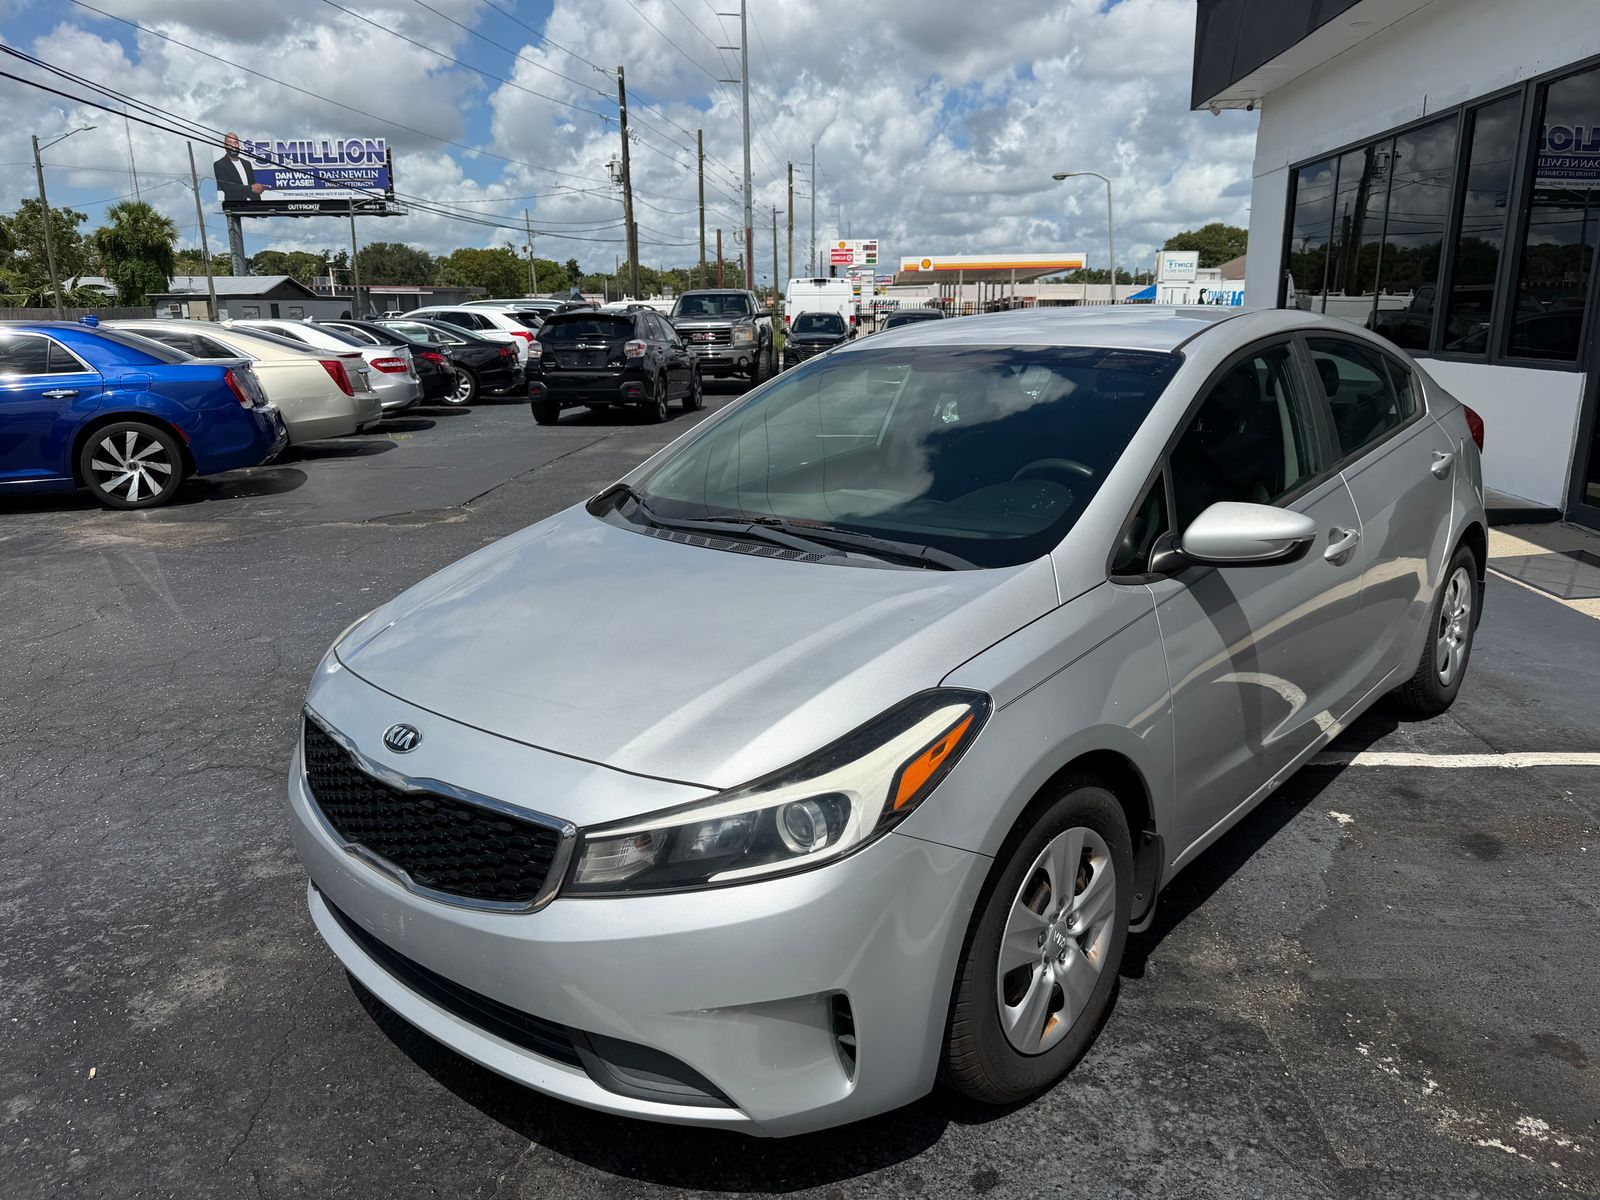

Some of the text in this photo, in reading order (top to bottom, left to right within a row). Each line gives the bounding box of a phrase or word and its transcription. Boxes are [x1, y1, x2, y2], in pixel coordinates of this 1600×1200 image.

[275, 138, 386, 165] MILLION
[319, 170, 379, 179] DAN NEWLIN
[386, 725, 415, 749] KIA
